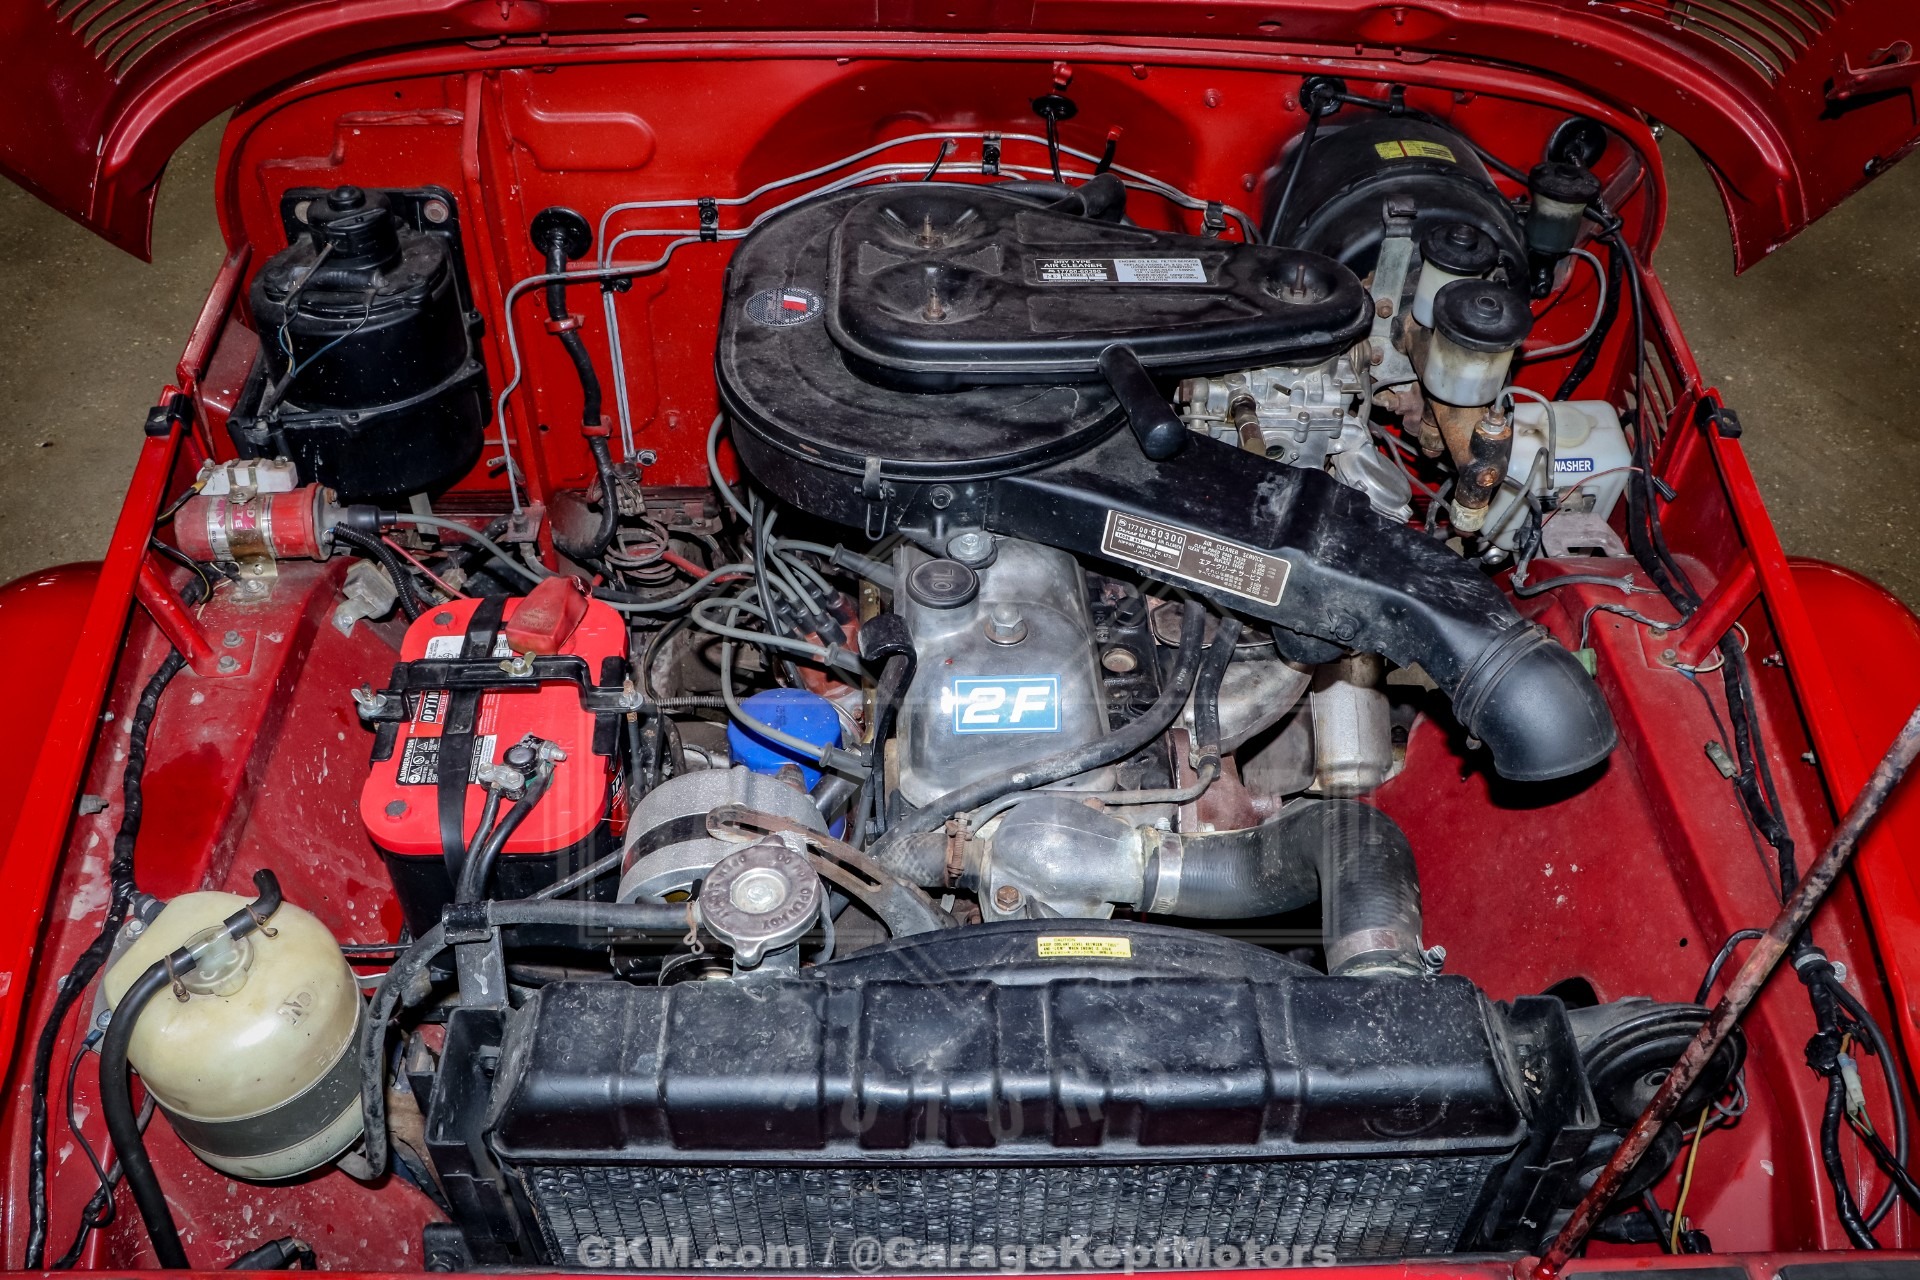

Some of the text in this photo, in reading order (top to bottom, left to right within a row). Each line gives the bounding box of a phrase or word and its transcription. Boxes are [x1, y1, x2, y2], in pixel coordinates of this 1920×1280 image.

[1133, 549, 1157, 558] JAPAN
[1215, 543, 1239, 555] CLEANER
[1242, 552, 1263, 563] SERVICE
[932, 569, 954, 589] OIL
[422, 690, 441, 722] OPTIM
[961, 686, 1051, 724] 2F
